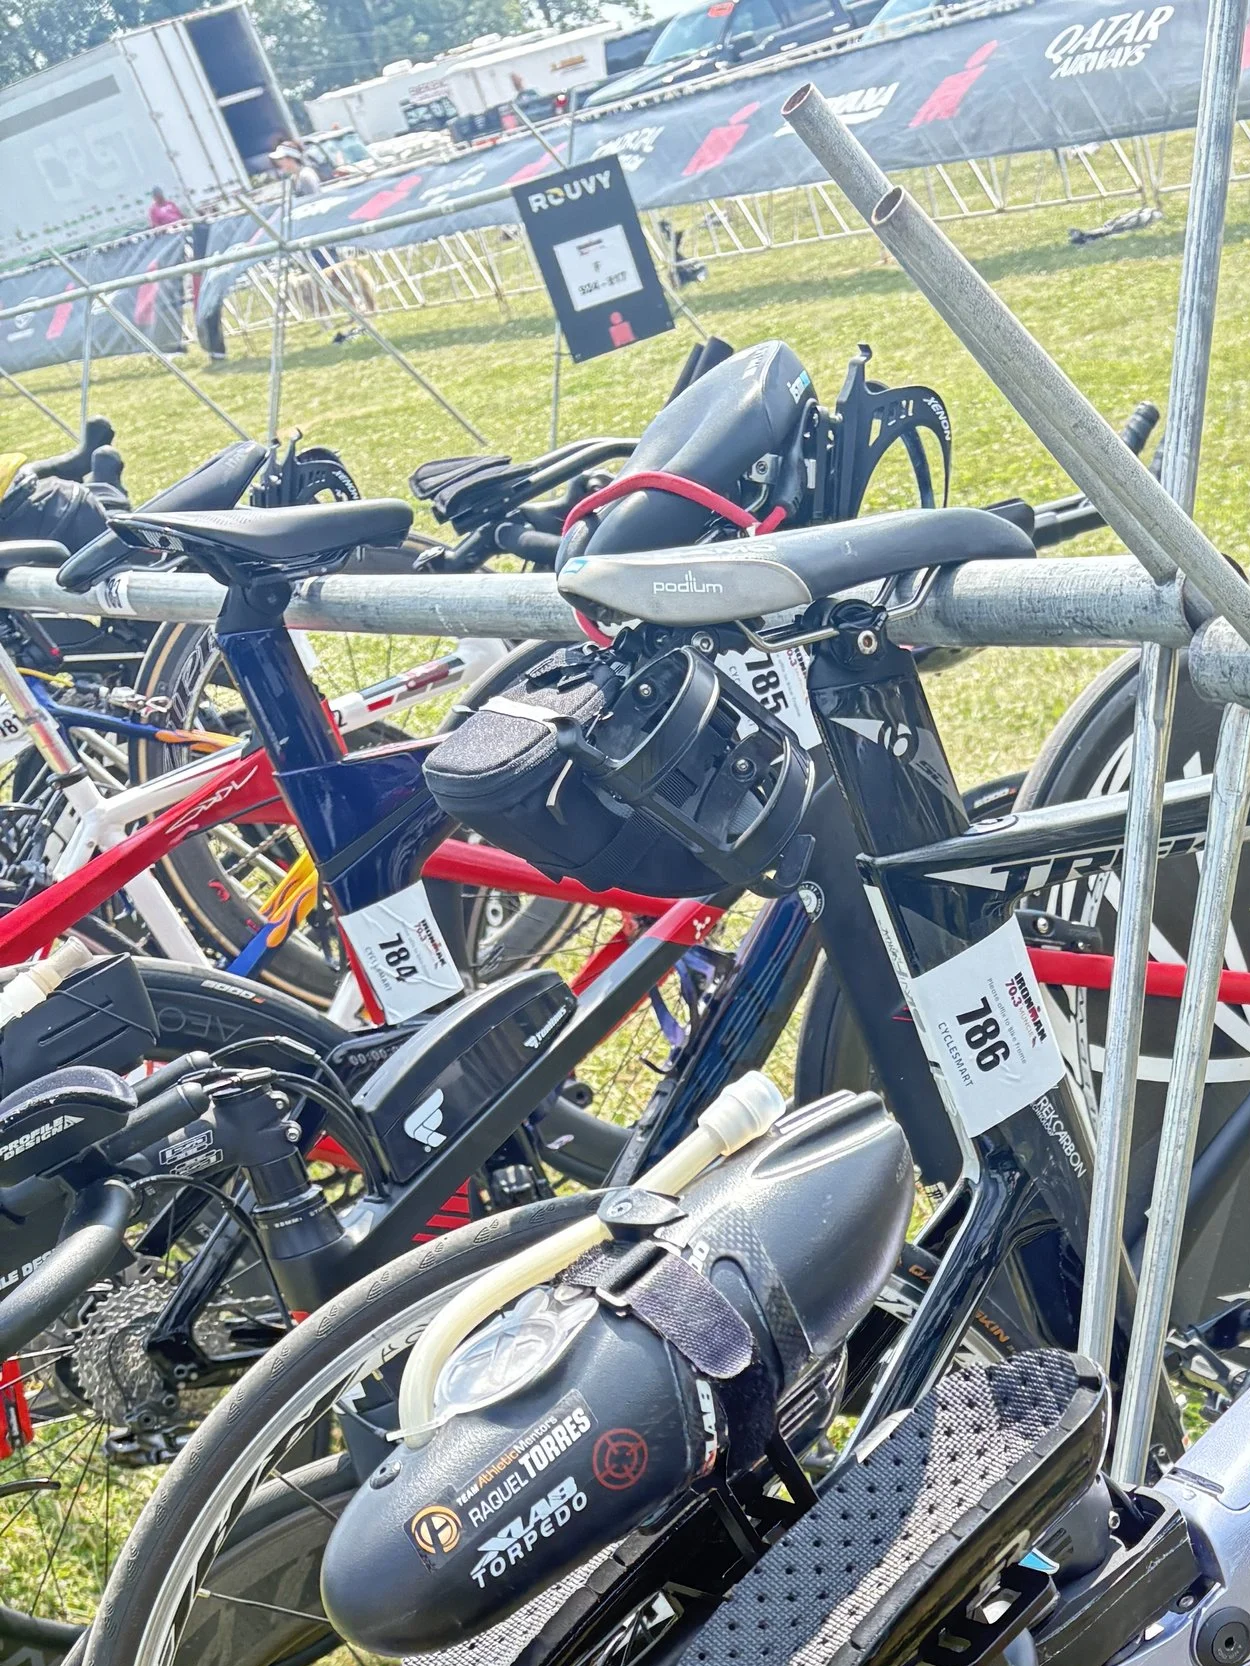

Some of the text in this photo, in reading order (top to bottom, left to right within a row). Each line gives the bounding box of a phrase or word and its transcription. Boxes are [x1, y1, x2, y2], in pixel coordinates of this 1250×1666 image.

[1044, 5, 1175, 63] QATAR
[1049, 44, 1152, 80] AIRWAYS
[528, 170, 611, 213] ROUVY
[922, 396, 951, 441] XENON
[653, 570, 723, 594] podium
[745, 652, 789, 714] 785
[379, 932, 418, 983] 784
[421, 918, 447, 967] IRONMAN
[987, 977, 1001, 1003] Please
[1004, 978, 1034, 1038] 70.3 MUNCIE
[1013, 971, 1048, 1044] IRONMAN
[937, 1021, 975, 1088] CYCLESMART
[956, 996, 1011, 1072] 786
[4, 1123, 64, 1162] DESIGN
[456, 1414, 558, 1507] TEAM AthleticMentors
[468, 1406, 591, 1528] RAQUEL TORRES
[470, 1475, 578, 1577] XLAB
[471, 1490, 588, 1590] TORPEDO
